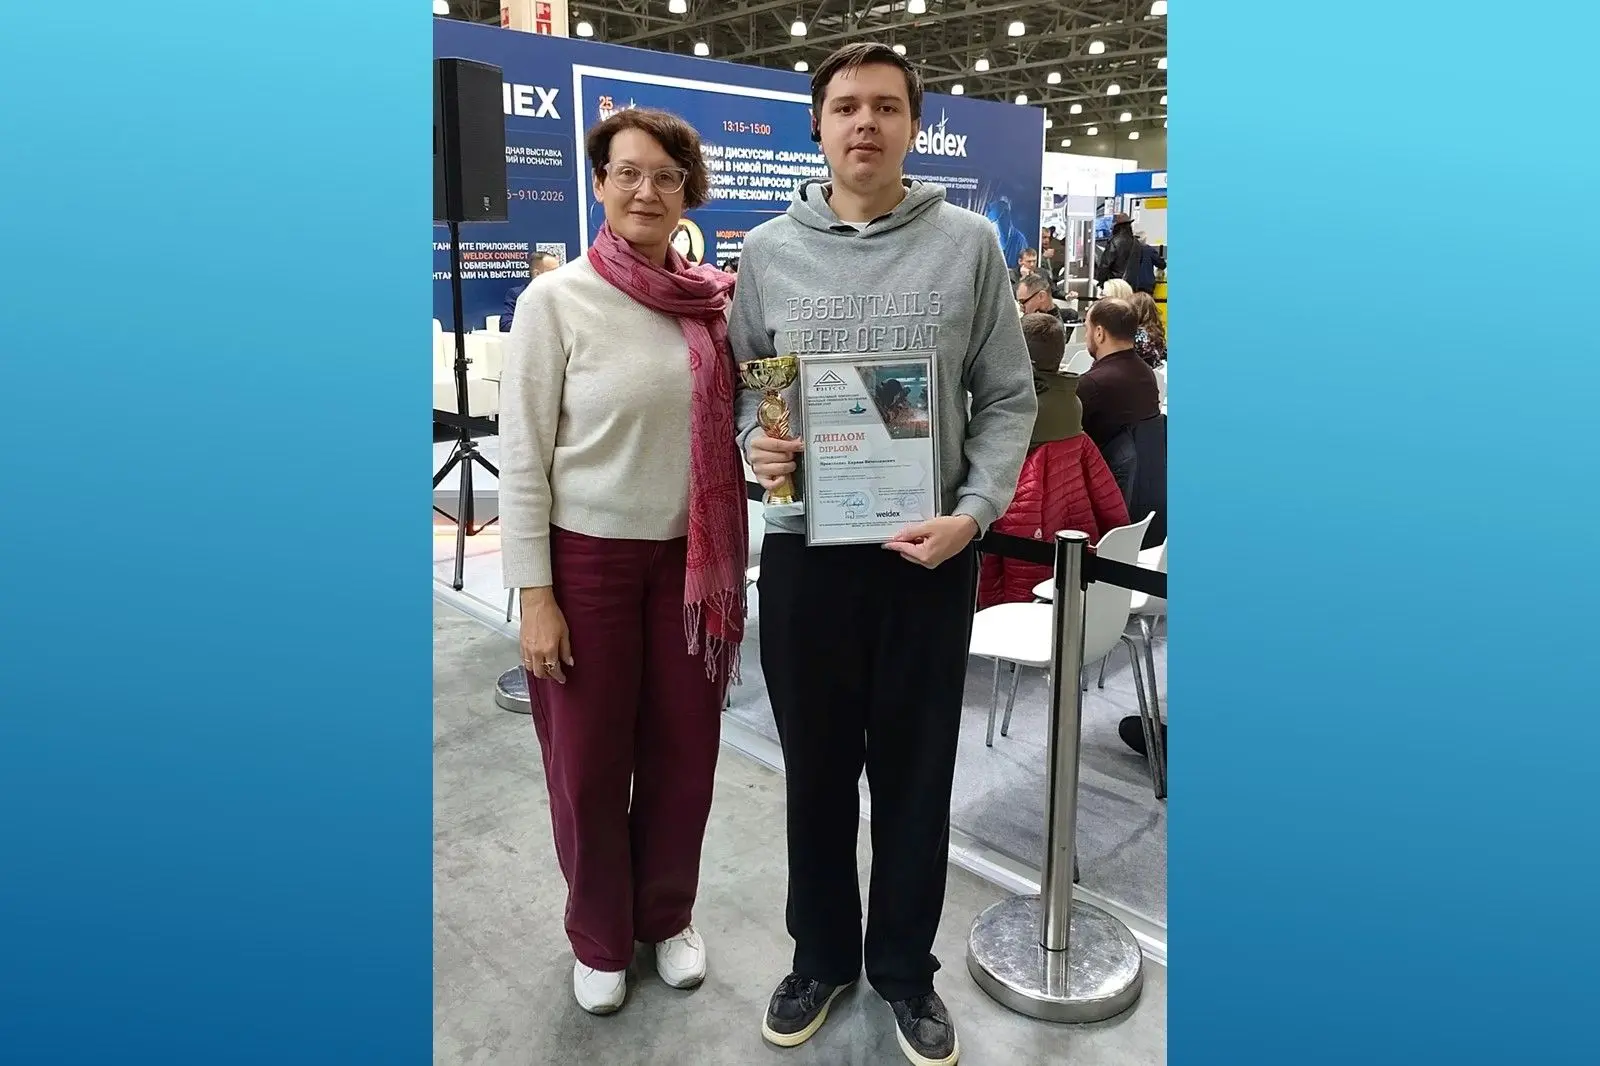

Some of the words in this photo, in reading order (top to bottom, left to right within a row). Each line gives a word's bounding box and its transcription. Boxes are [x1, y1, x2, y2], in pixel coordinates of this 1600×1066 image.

[599, 95, 613, 110] 25
[910, 123, 967, 157] eldex
[526, 148, 562, 157] ВЫСТАВКА
[725, 147, 774, 160] ДИСКУССИЯ
[526, 157, 563, 166] ОСНАСТКИ
[725, 161, 731, 171] В
[733, 160, 762, 173] НОВОЙ
[763, 164, 828, 177] ПРОМЫШЛЕННОЙ
[737, 175, 748, 186] ОТ
[750, 176, 791, 188] ЗАПРОСОВ
[476, 242, 529, 251] ПРИЛОЖЕНИЕ
[463, 252, 493, 260] WELDEX
[494, 252, 528, 260] CONNECT
[463, 260, 530, 270] ОБМЕНИВАЙТЕСЬ
[478, 271, 489, 279] НА
[490, 270, 531, 279] ВЫСТАВКЕ
[786, 290, 942, 323] ESSENTAILS
[856, 325, 887, 352] OF
[813, 432, 866, 444] ДИПЛОМ
[819, 444, 859, 453] DIPLOMA
[876, 509, 901, 518] weldex
